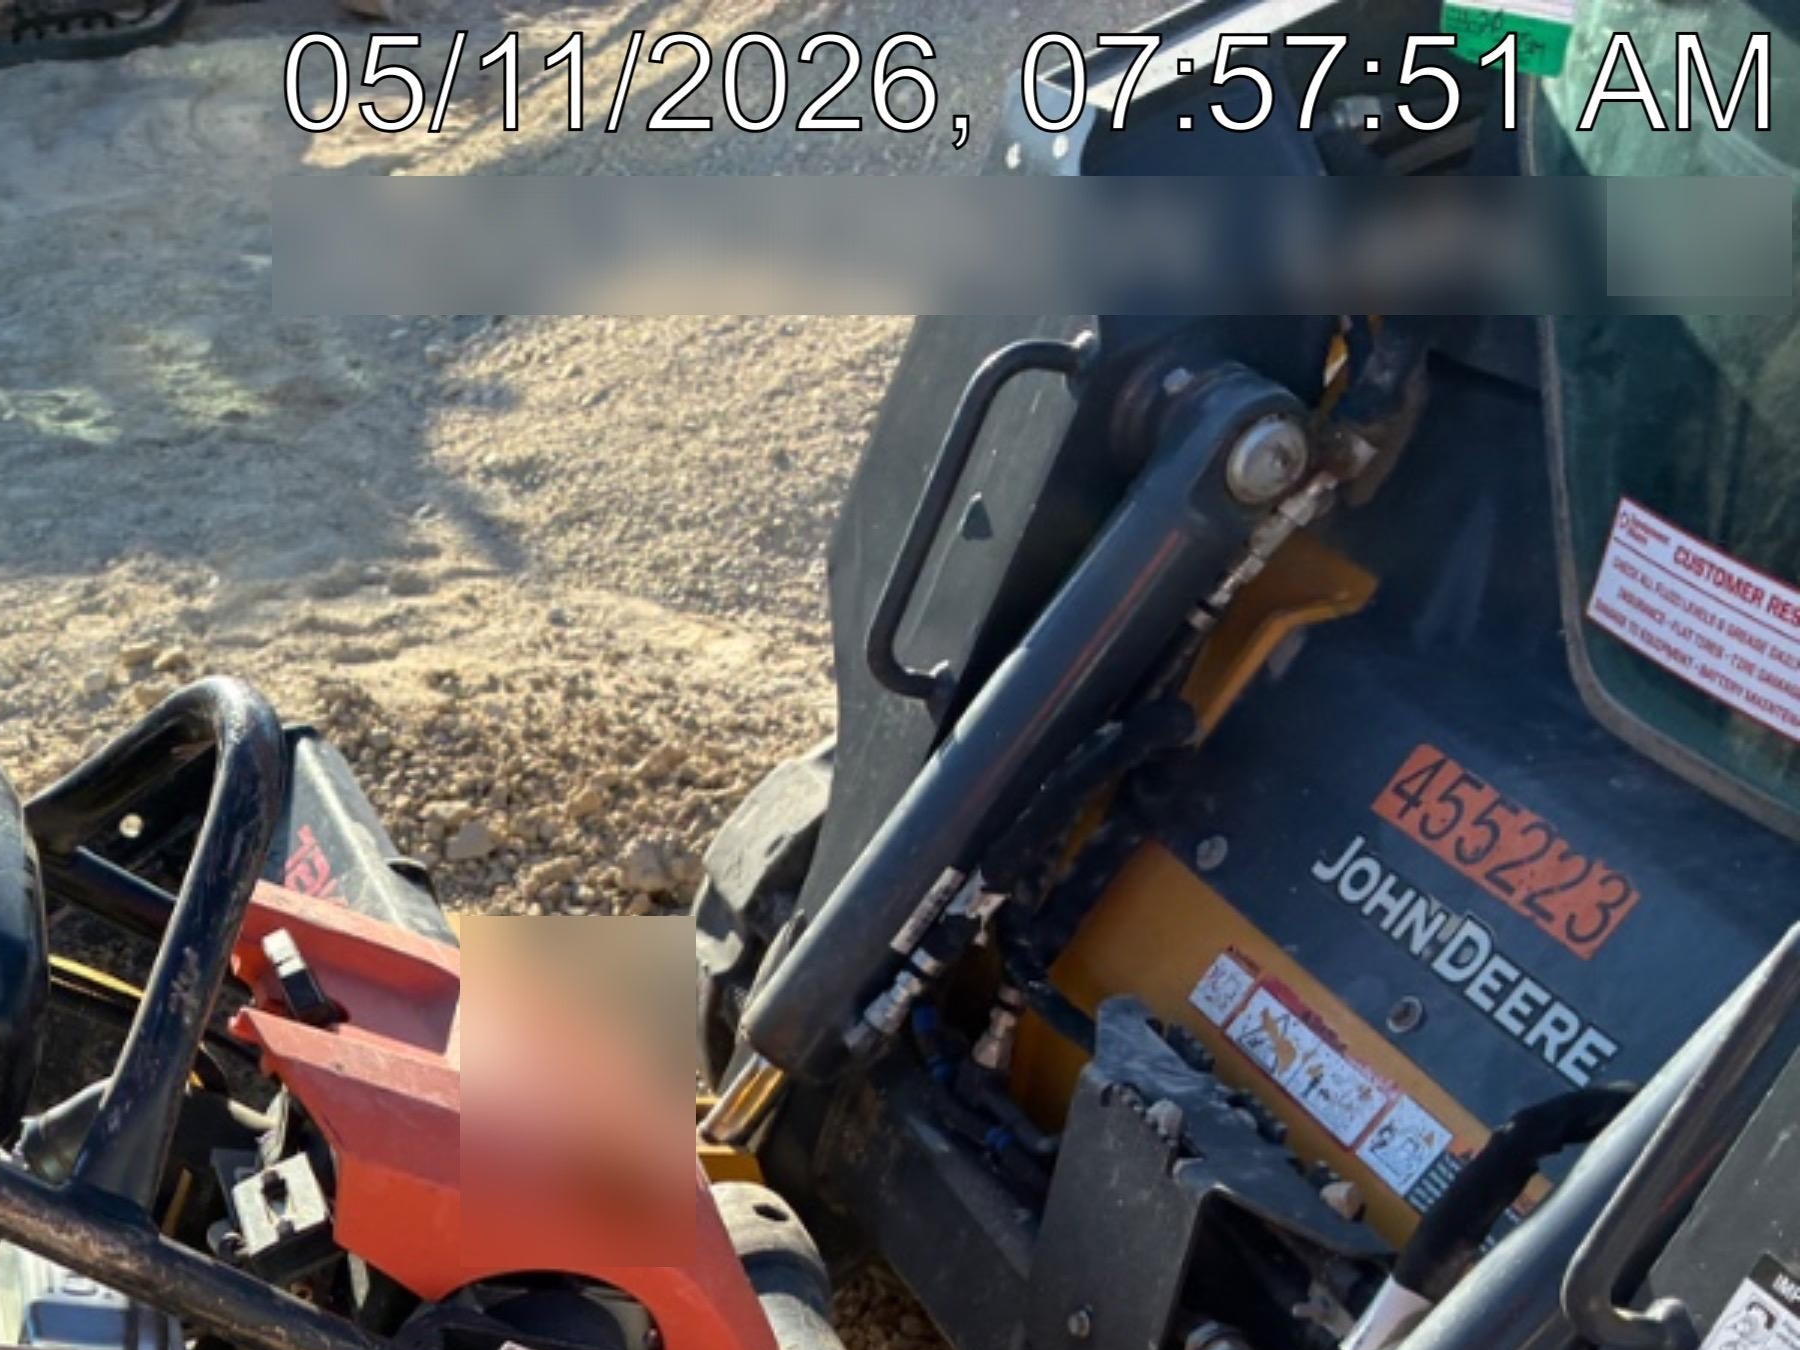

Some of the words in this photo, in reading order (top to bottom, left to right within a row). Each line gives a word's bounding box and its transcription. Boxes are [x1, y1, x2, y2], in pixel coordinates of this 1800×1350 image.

[1673, 545, 1766, 606] CUSTOMER
[1390, 757, 1633, 946] 455223
[1311, 835, 1446, 958] JOHN
[1432, 912, 1620, 1090] DEERE
